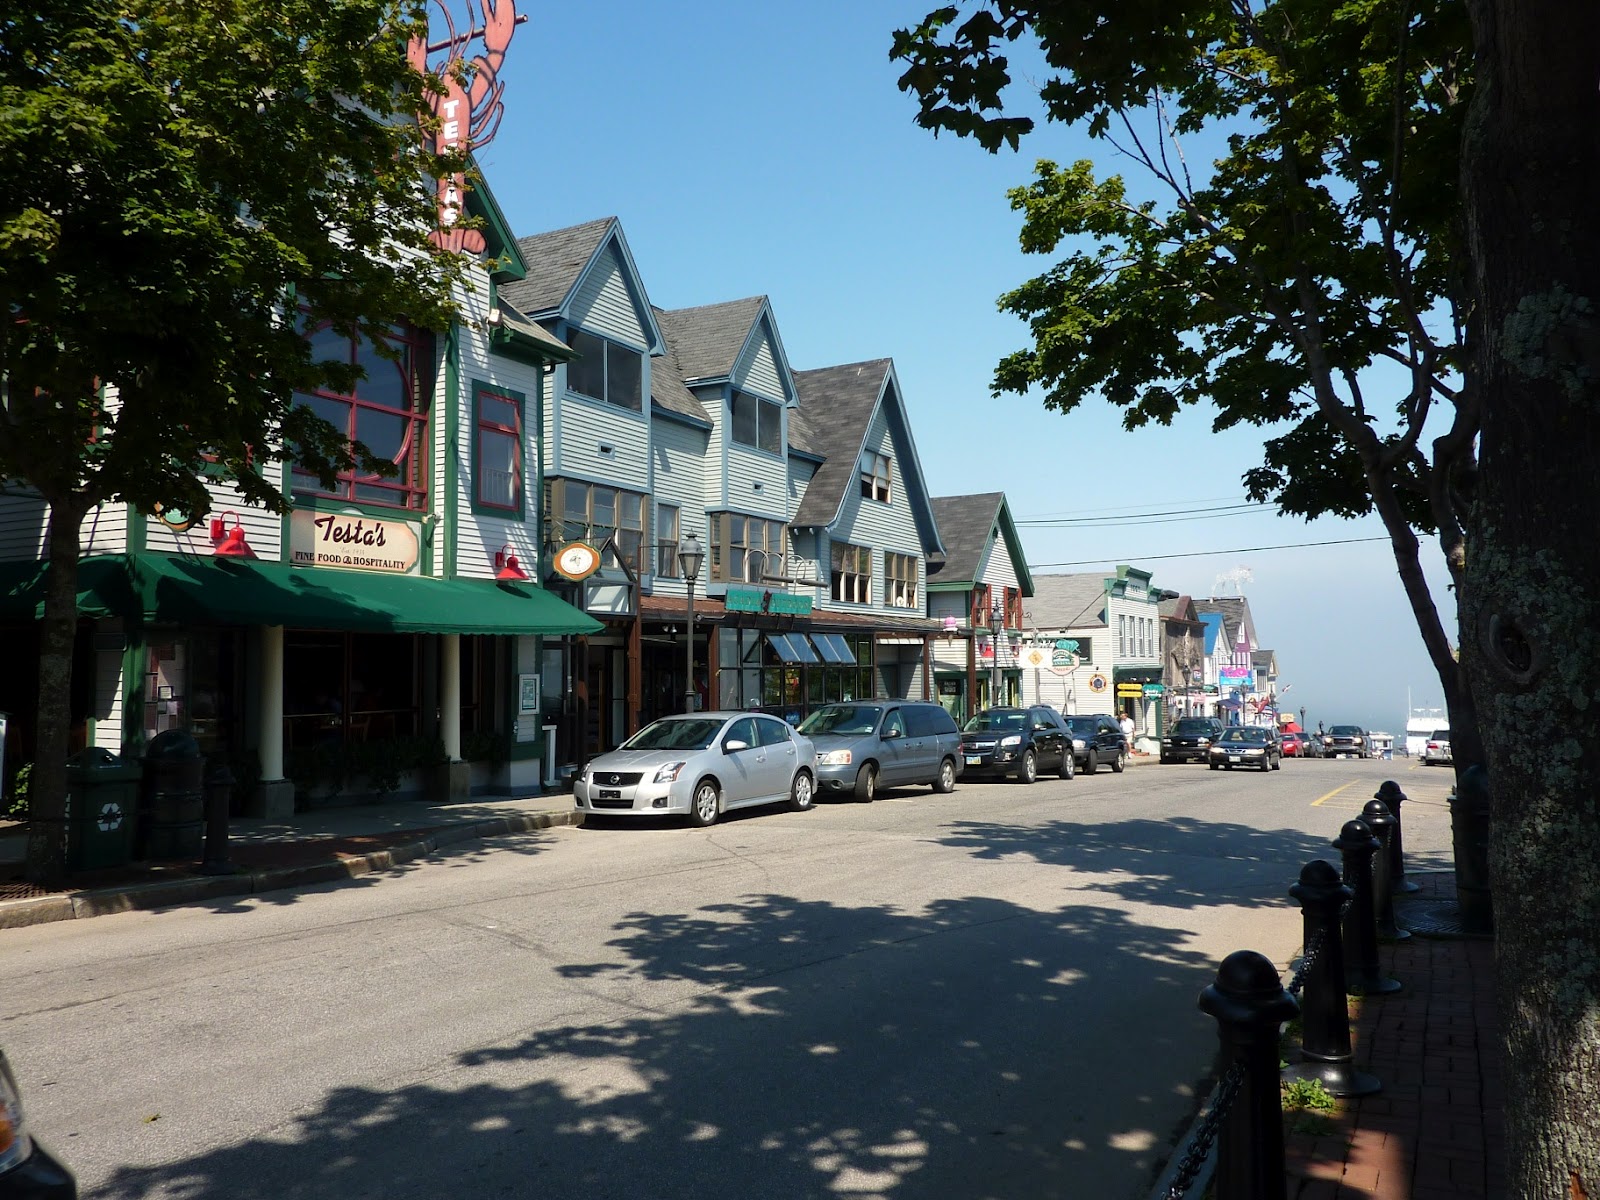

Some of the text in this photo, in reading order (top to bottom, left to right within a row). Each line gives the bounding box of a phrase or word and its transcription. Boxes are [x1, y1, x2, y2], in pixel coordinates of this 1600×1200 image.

[314, 515, 386, 547] Testa's
[295, 551, 315, 561] FINE
[318, 553, 341, 564] FOOD
[353, 556, 406, 569] HOSPITALITY
